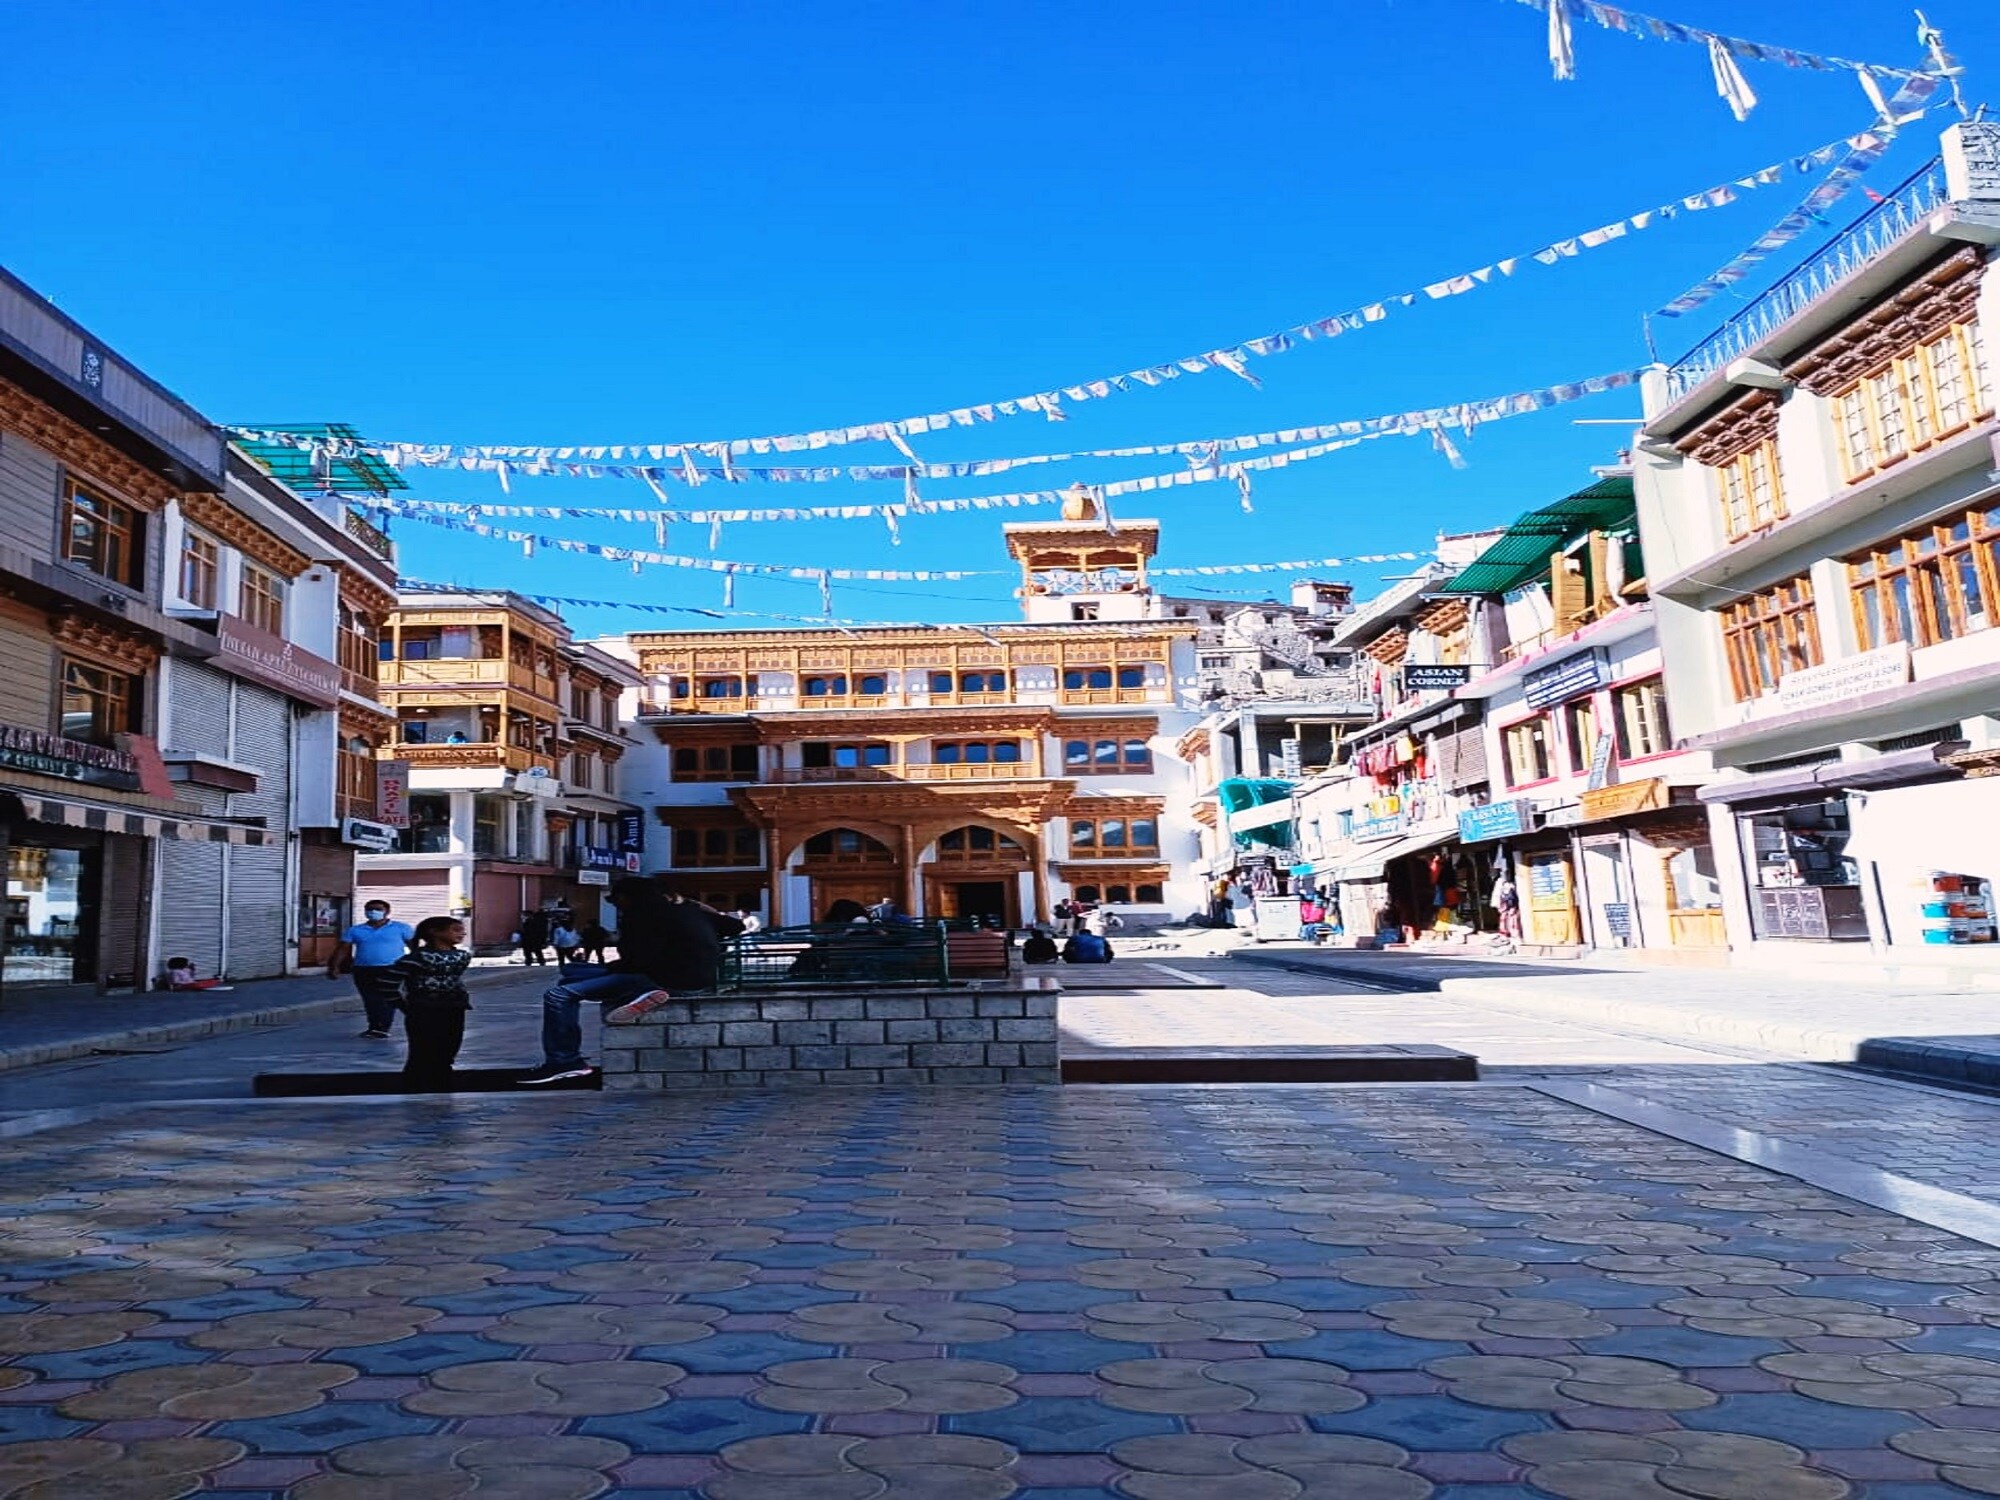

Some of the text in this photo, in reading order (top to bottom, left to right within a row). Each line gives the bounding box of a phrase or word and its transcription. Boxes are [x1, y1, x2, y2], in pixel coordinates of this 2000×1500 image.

[1412, 668, 1463, 676] ASIAN
[1407, 677, 1466, 685] CORNER
[623, 816, 639, 847] Amul
